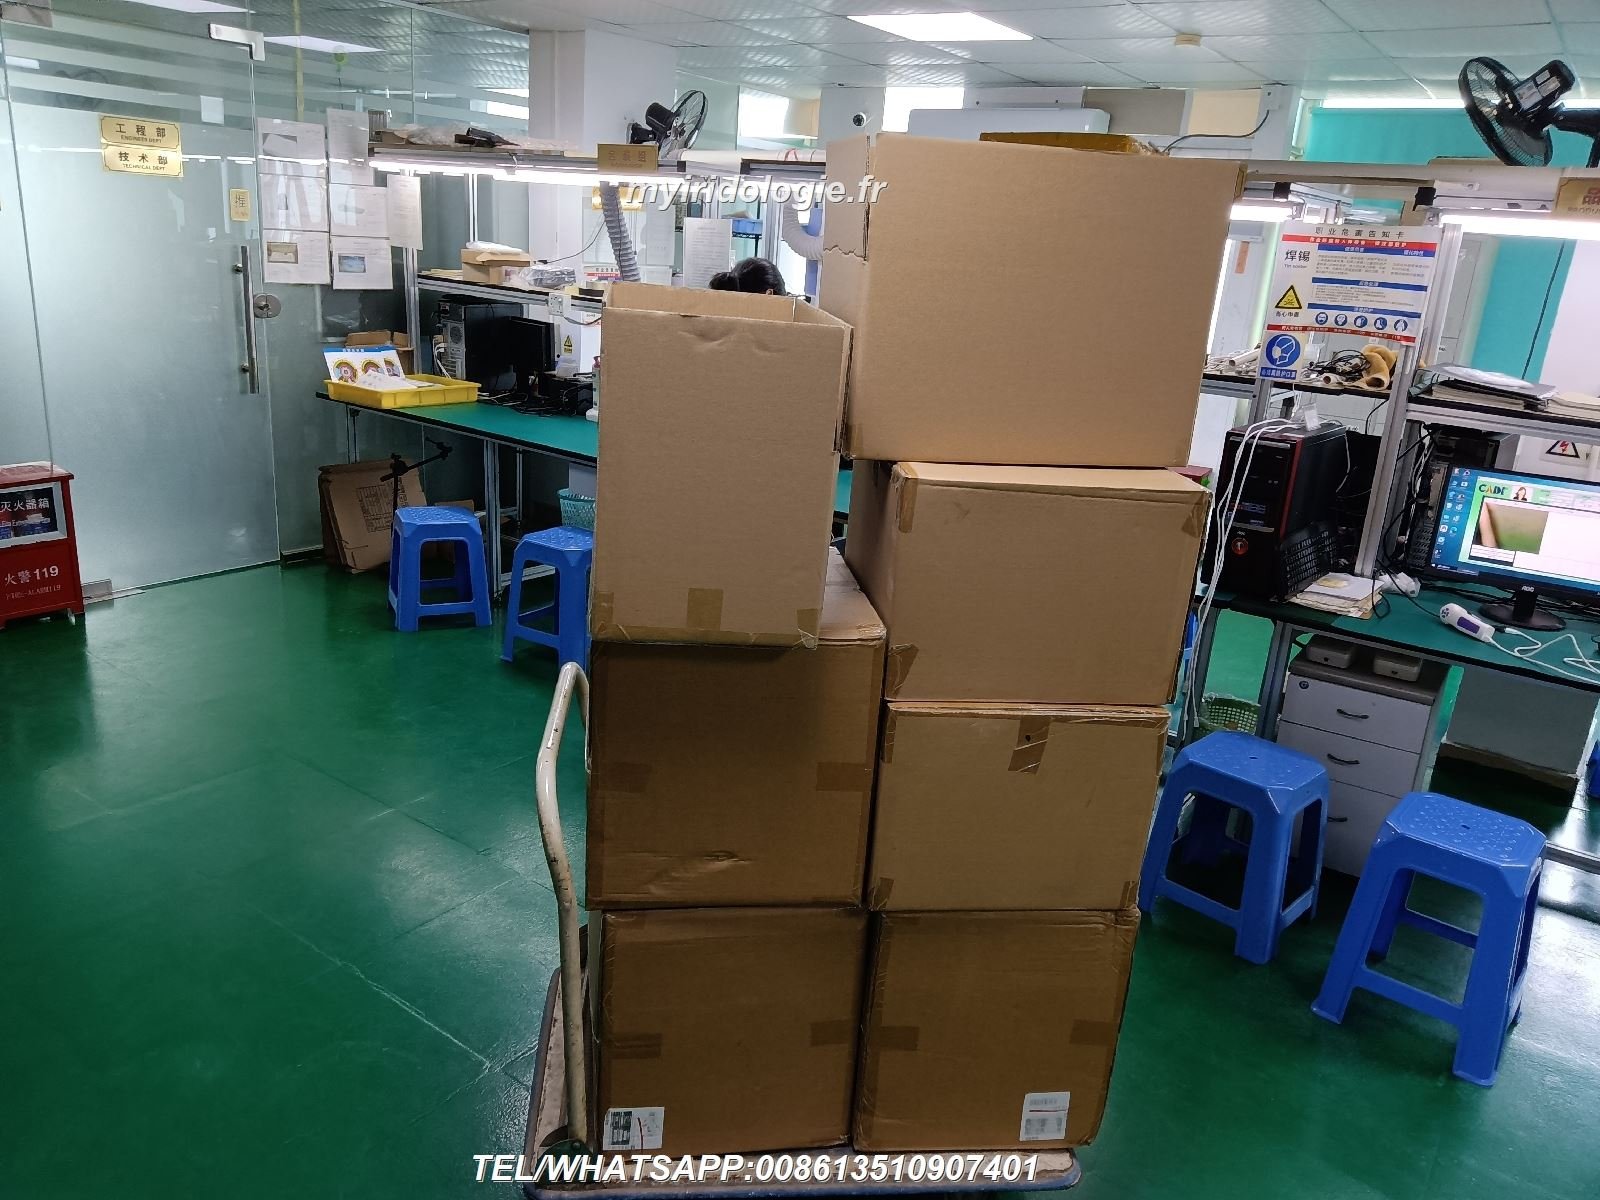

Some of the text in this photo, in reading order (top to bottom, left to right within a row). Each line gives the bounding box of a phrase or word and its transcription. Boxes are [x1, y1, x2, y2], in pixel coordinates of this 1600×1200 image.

[115, 123, 166, 138] 工程部
[118, 151, 168, 165] 技术部
[1284, 249, 1310, 262] 焊锡
[0, 498, 50, 512] 灭火器箱
[4, 565, 59, 587] 火警119
